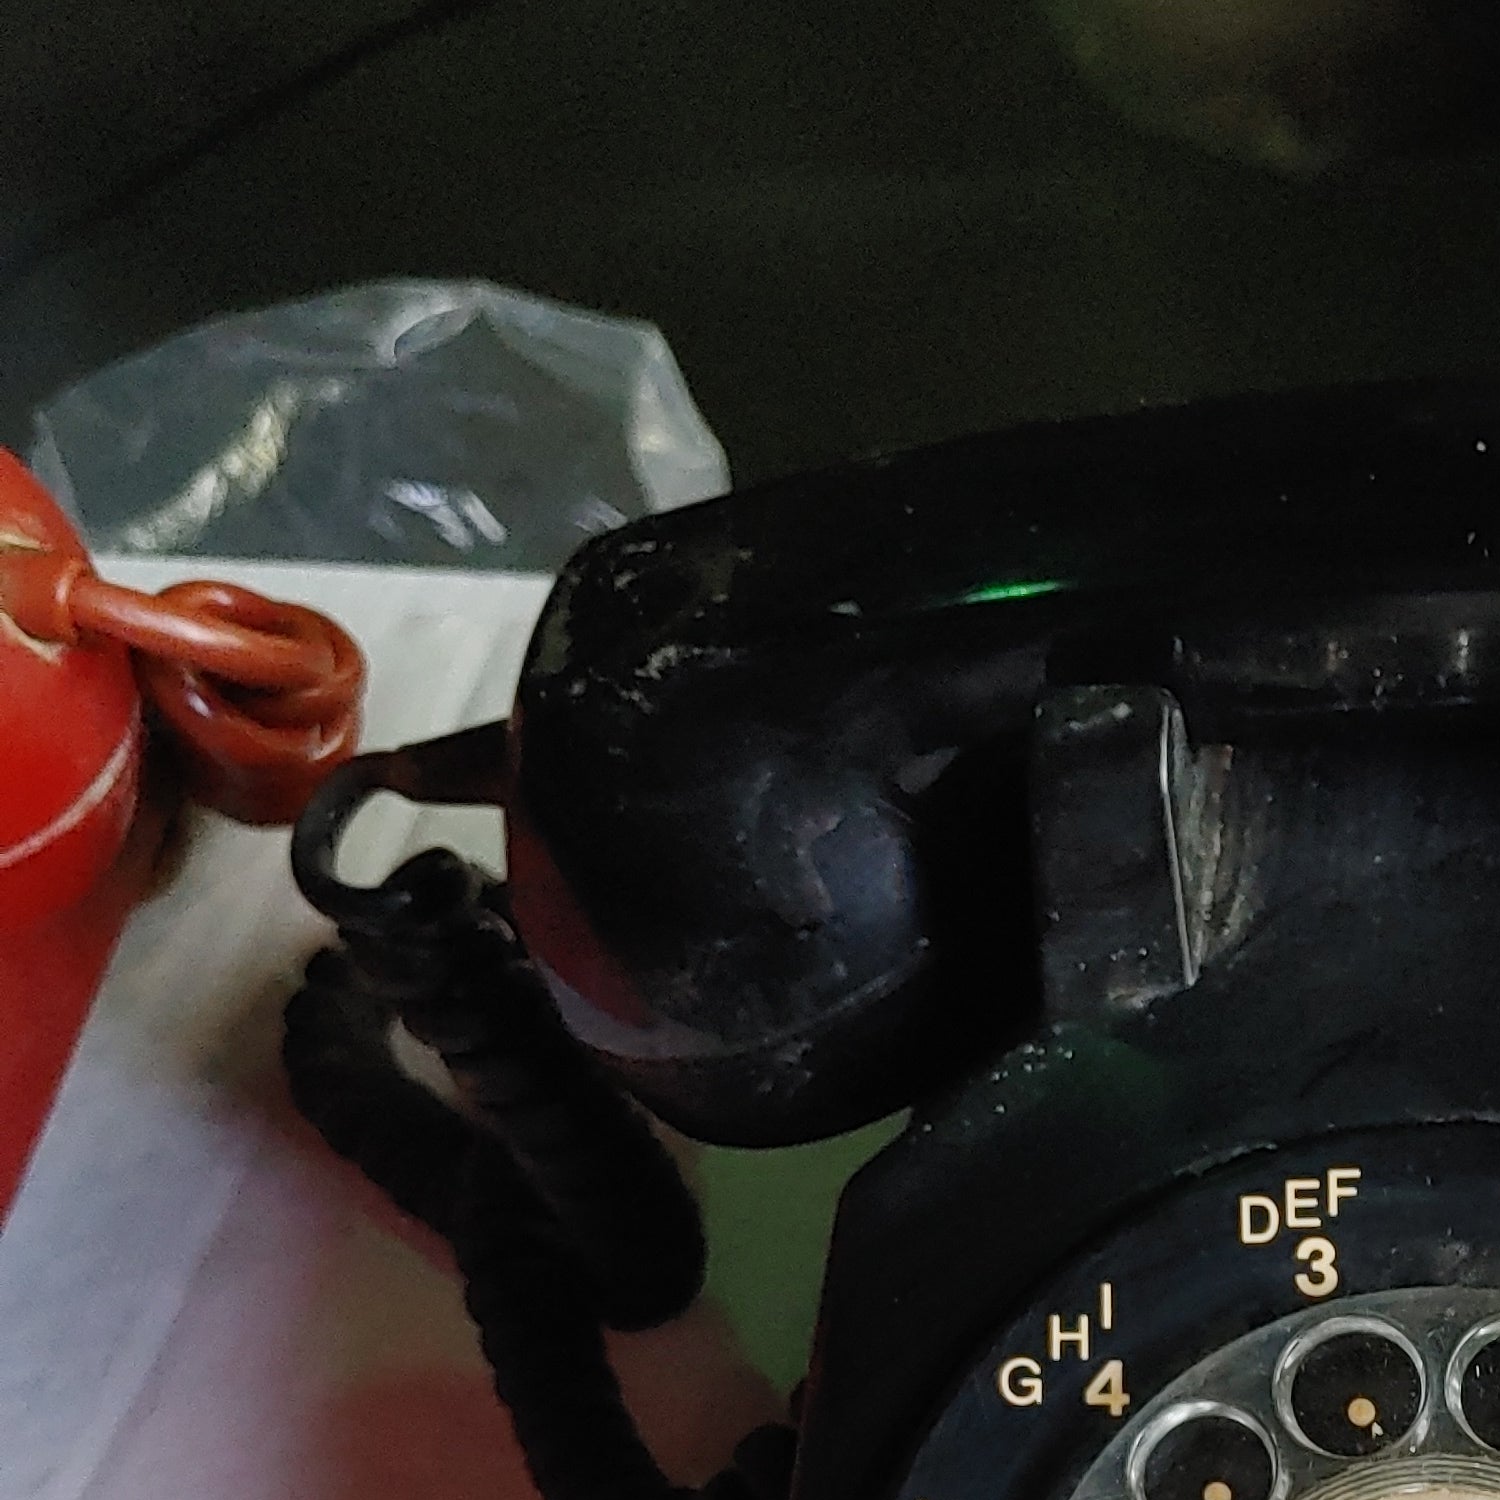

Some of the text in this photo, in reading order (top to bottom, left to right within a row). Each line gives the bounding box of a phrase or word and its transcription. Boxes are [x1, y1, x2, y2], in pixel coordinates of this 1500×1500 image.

[1241, 1168, 1361, 1245] DEF
[1295, 1238, 1339, 1297] 3
[1085, 1359, 1130, 1416] 4
